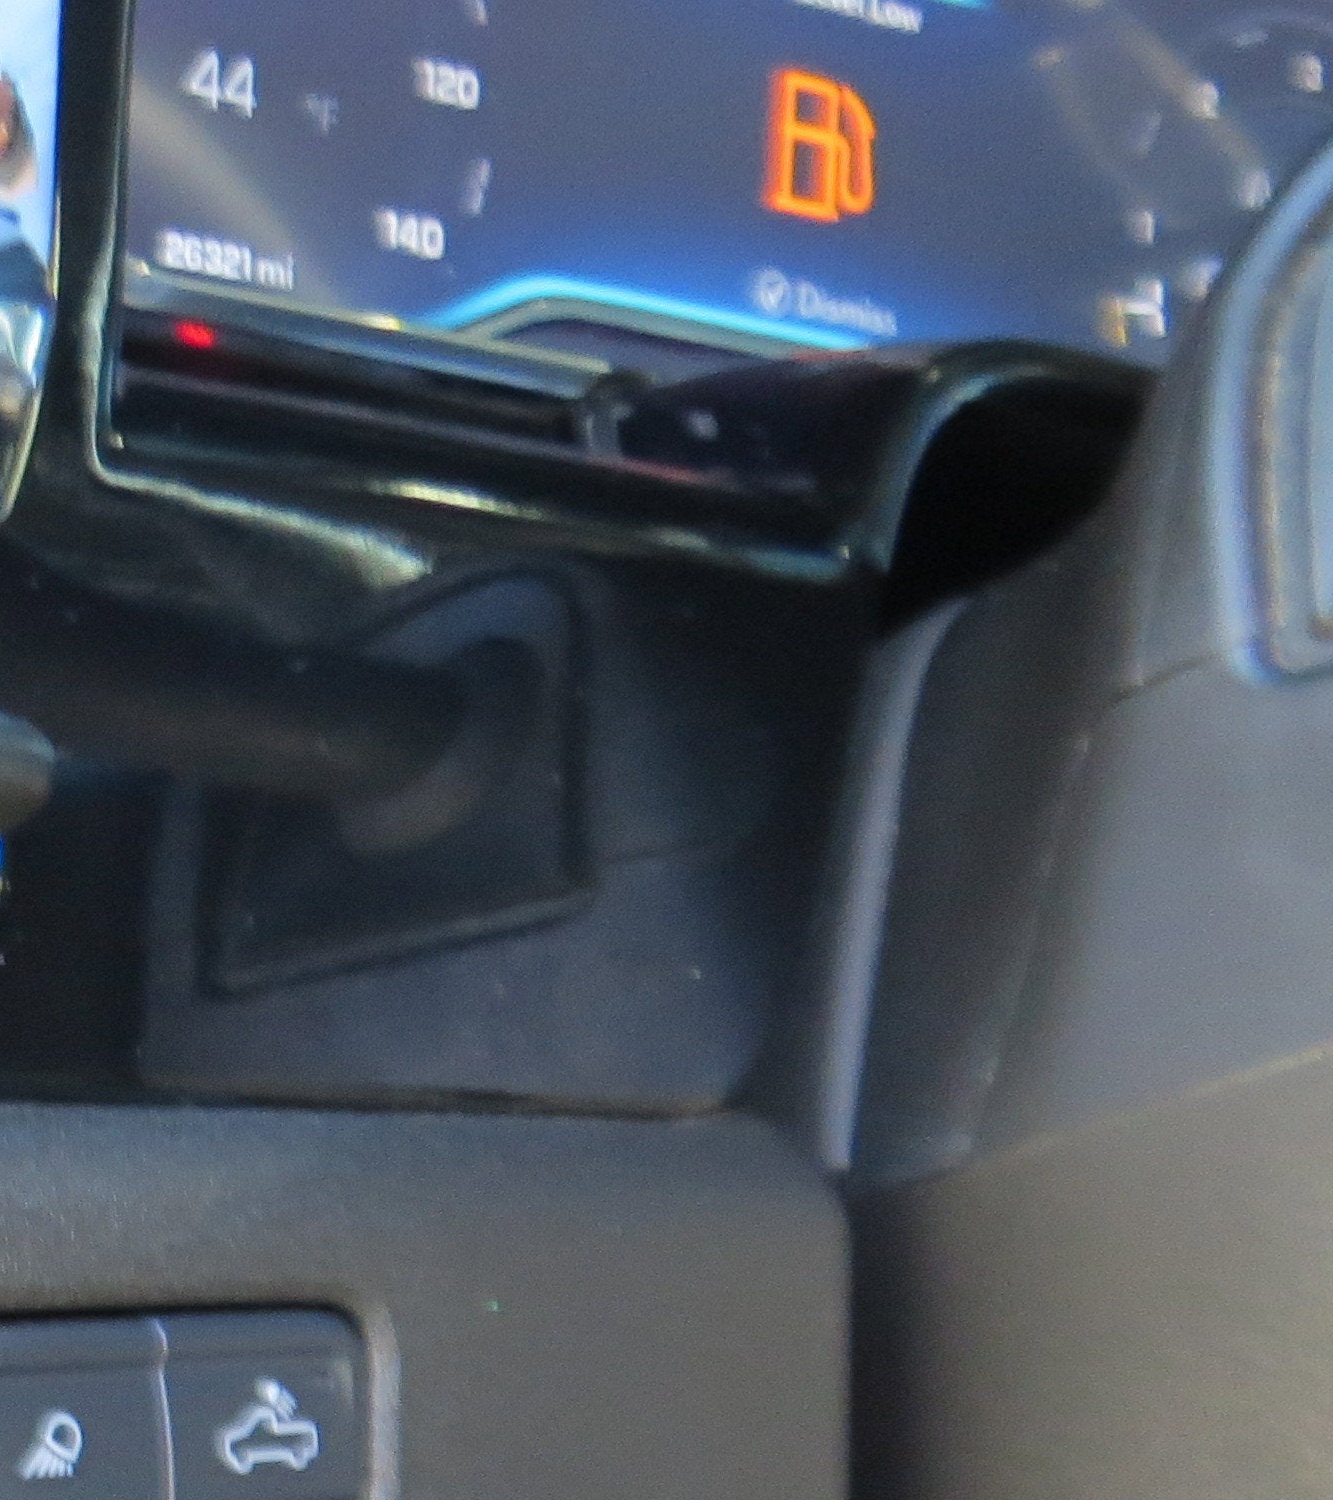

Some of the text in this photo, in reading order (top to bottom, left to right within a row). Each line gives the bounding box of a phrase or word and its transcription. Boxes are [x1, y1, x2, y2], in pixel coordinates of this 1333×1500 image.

[181, 47, 255, 118] 44
[412, 56, 482, 110] 120
[374, 208, 446, 260] 140
